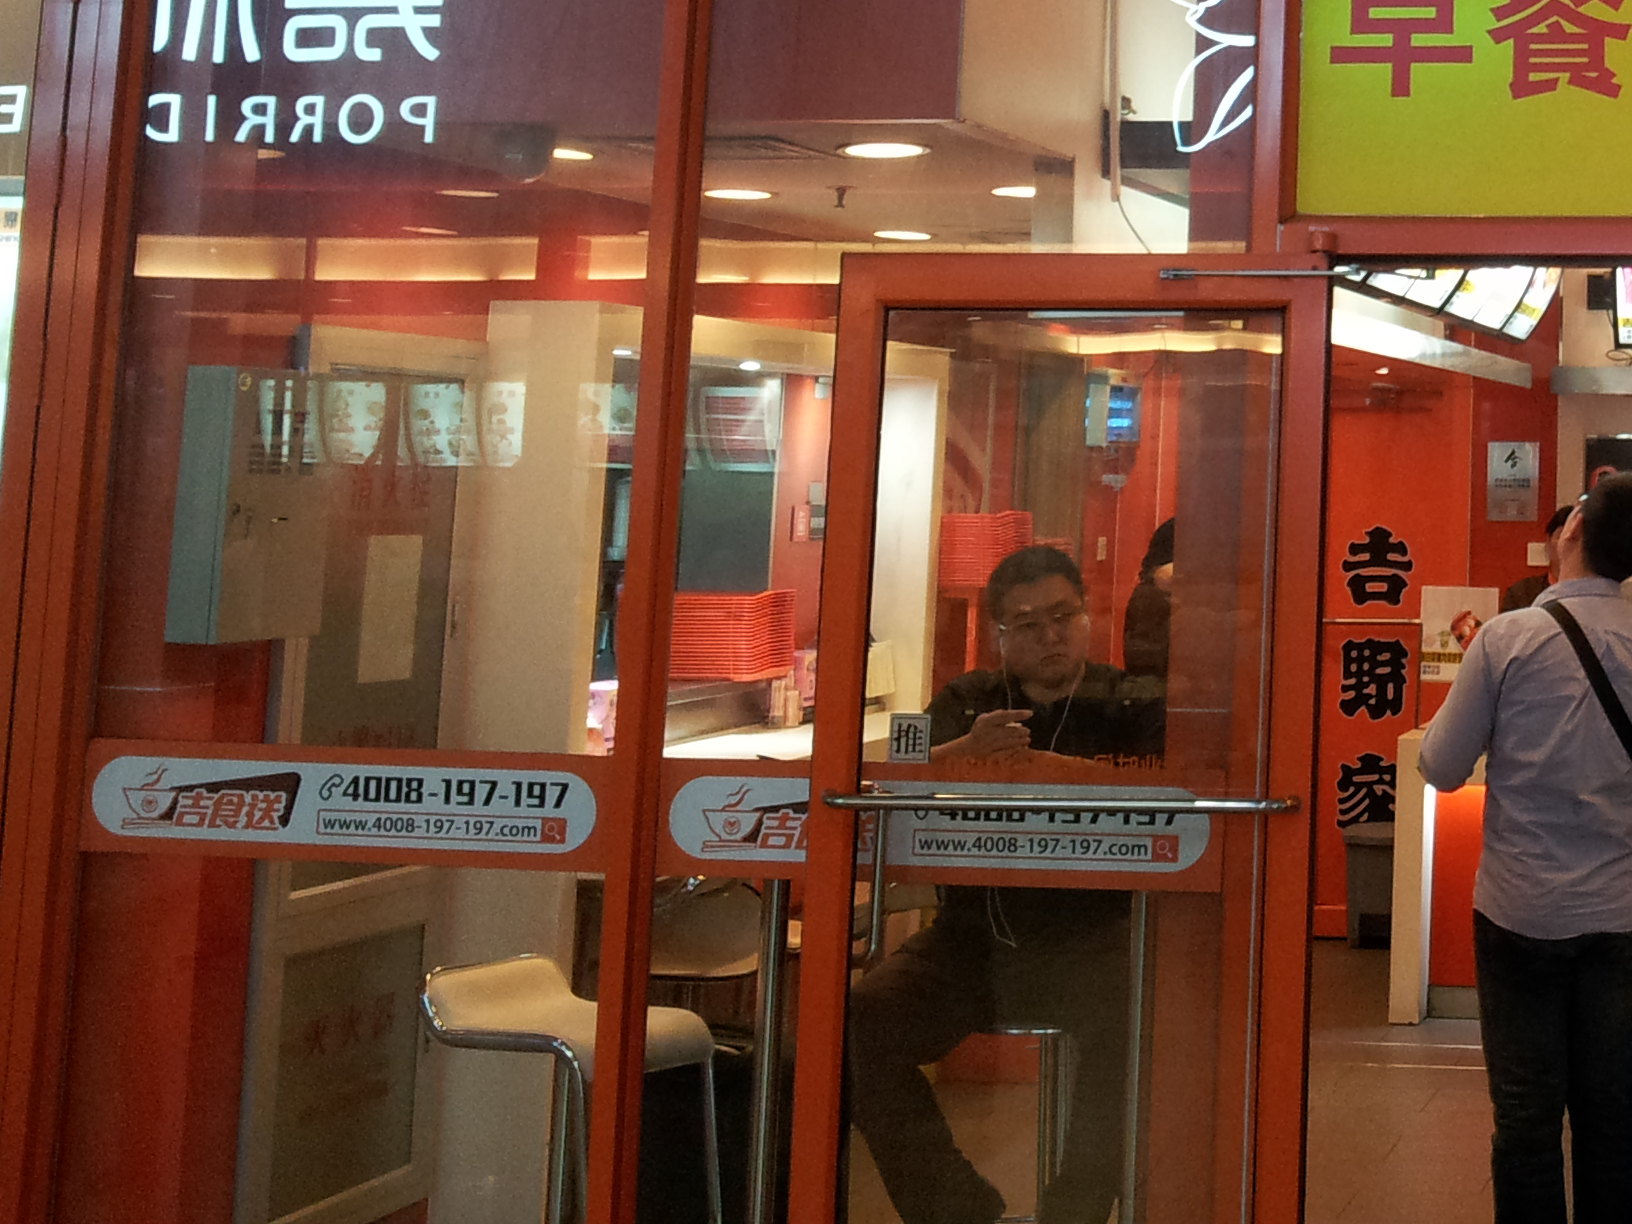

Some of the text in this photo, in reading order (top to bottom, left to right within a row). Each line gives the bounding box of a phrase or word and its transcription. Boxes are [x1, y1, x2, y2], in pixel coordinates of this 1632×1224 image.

[894, 720, 928, 756] 推
[173, 787, 287, 831] 吉食送
[342, 775, 569, 810] 4008-197-197
[322, 815, 538, 839] www.4008-197-197.com
[918, 835, 1148, 857] www.4008-197-197.com
